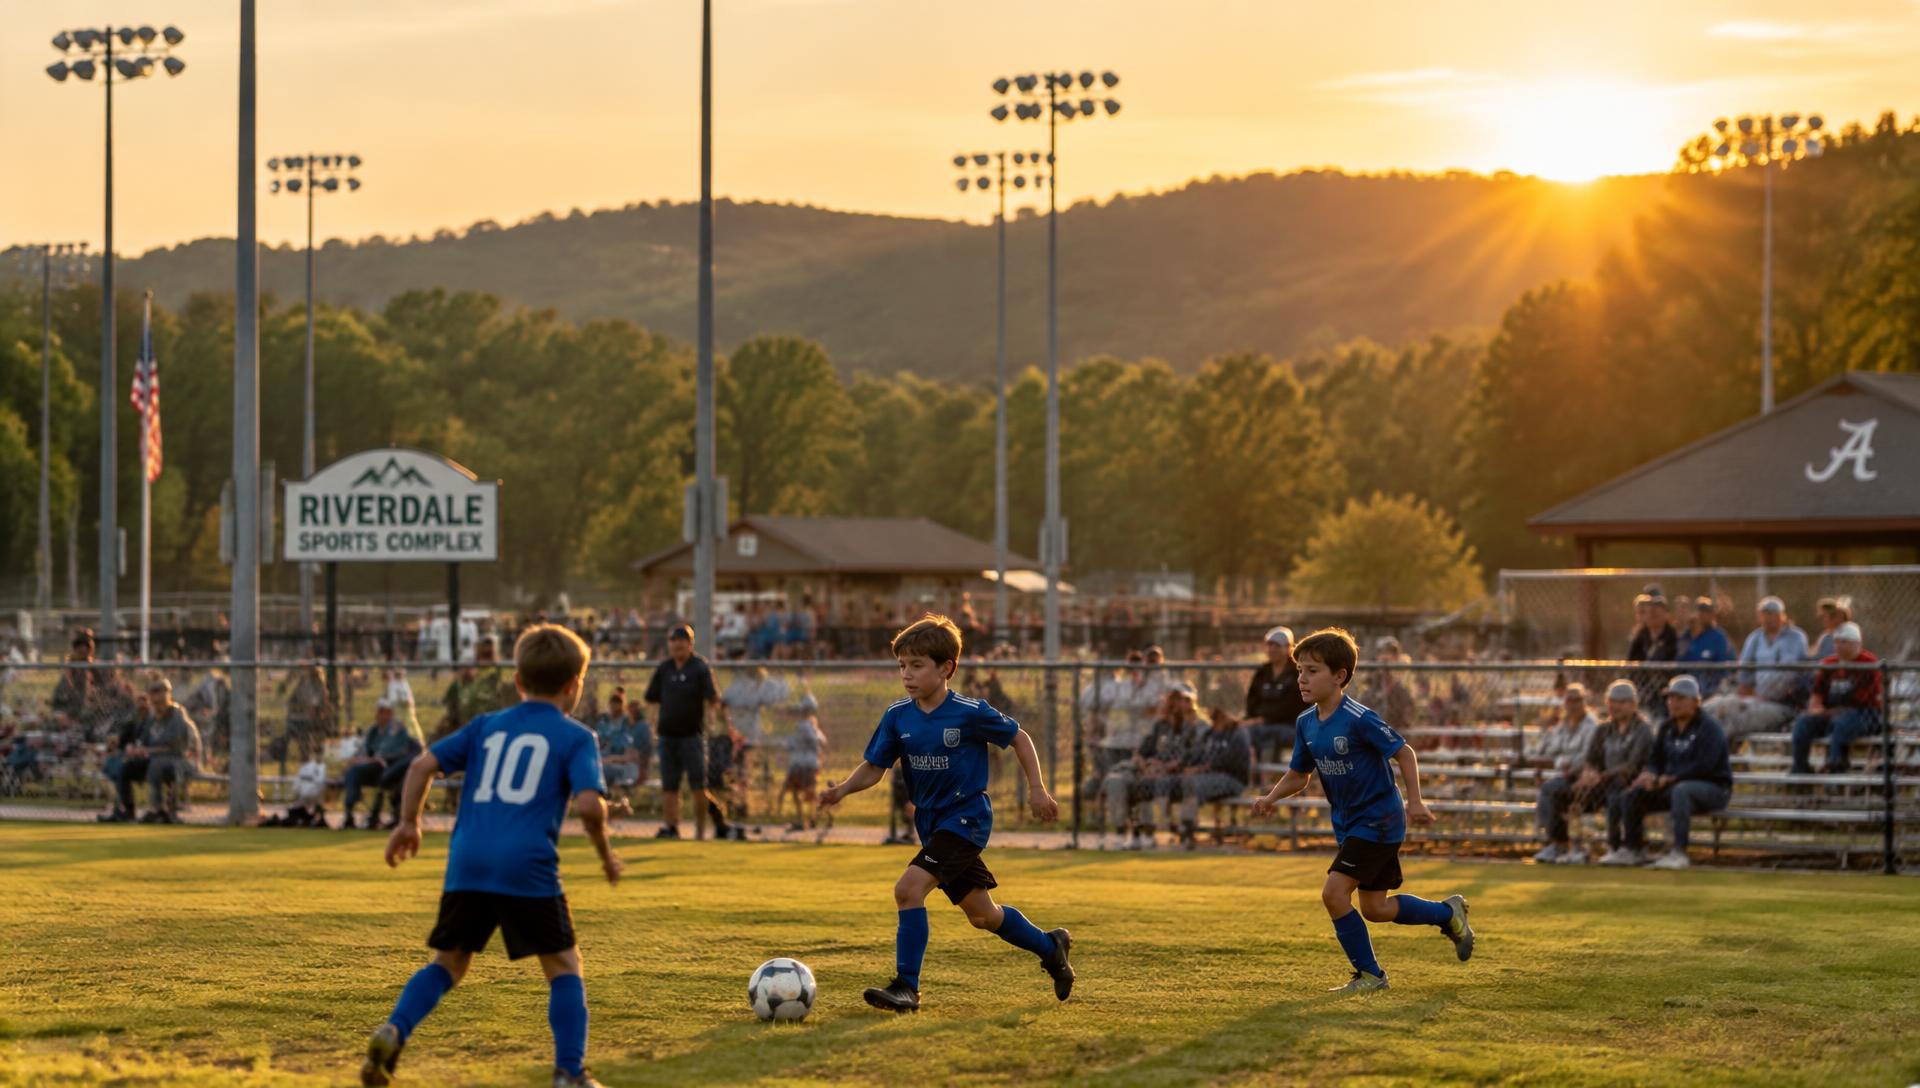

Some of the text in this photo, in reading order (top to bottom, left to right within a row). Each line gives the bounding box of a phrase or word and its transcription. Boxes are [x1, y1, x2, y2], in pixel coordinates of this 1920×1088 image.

[1805, 418, 1877, 481] A
[299, 494, 483, 525] RIVERDALE
[298, 532, 482, 551] SPORTS COMPLEX
[473, 731, 550, 805] 10
